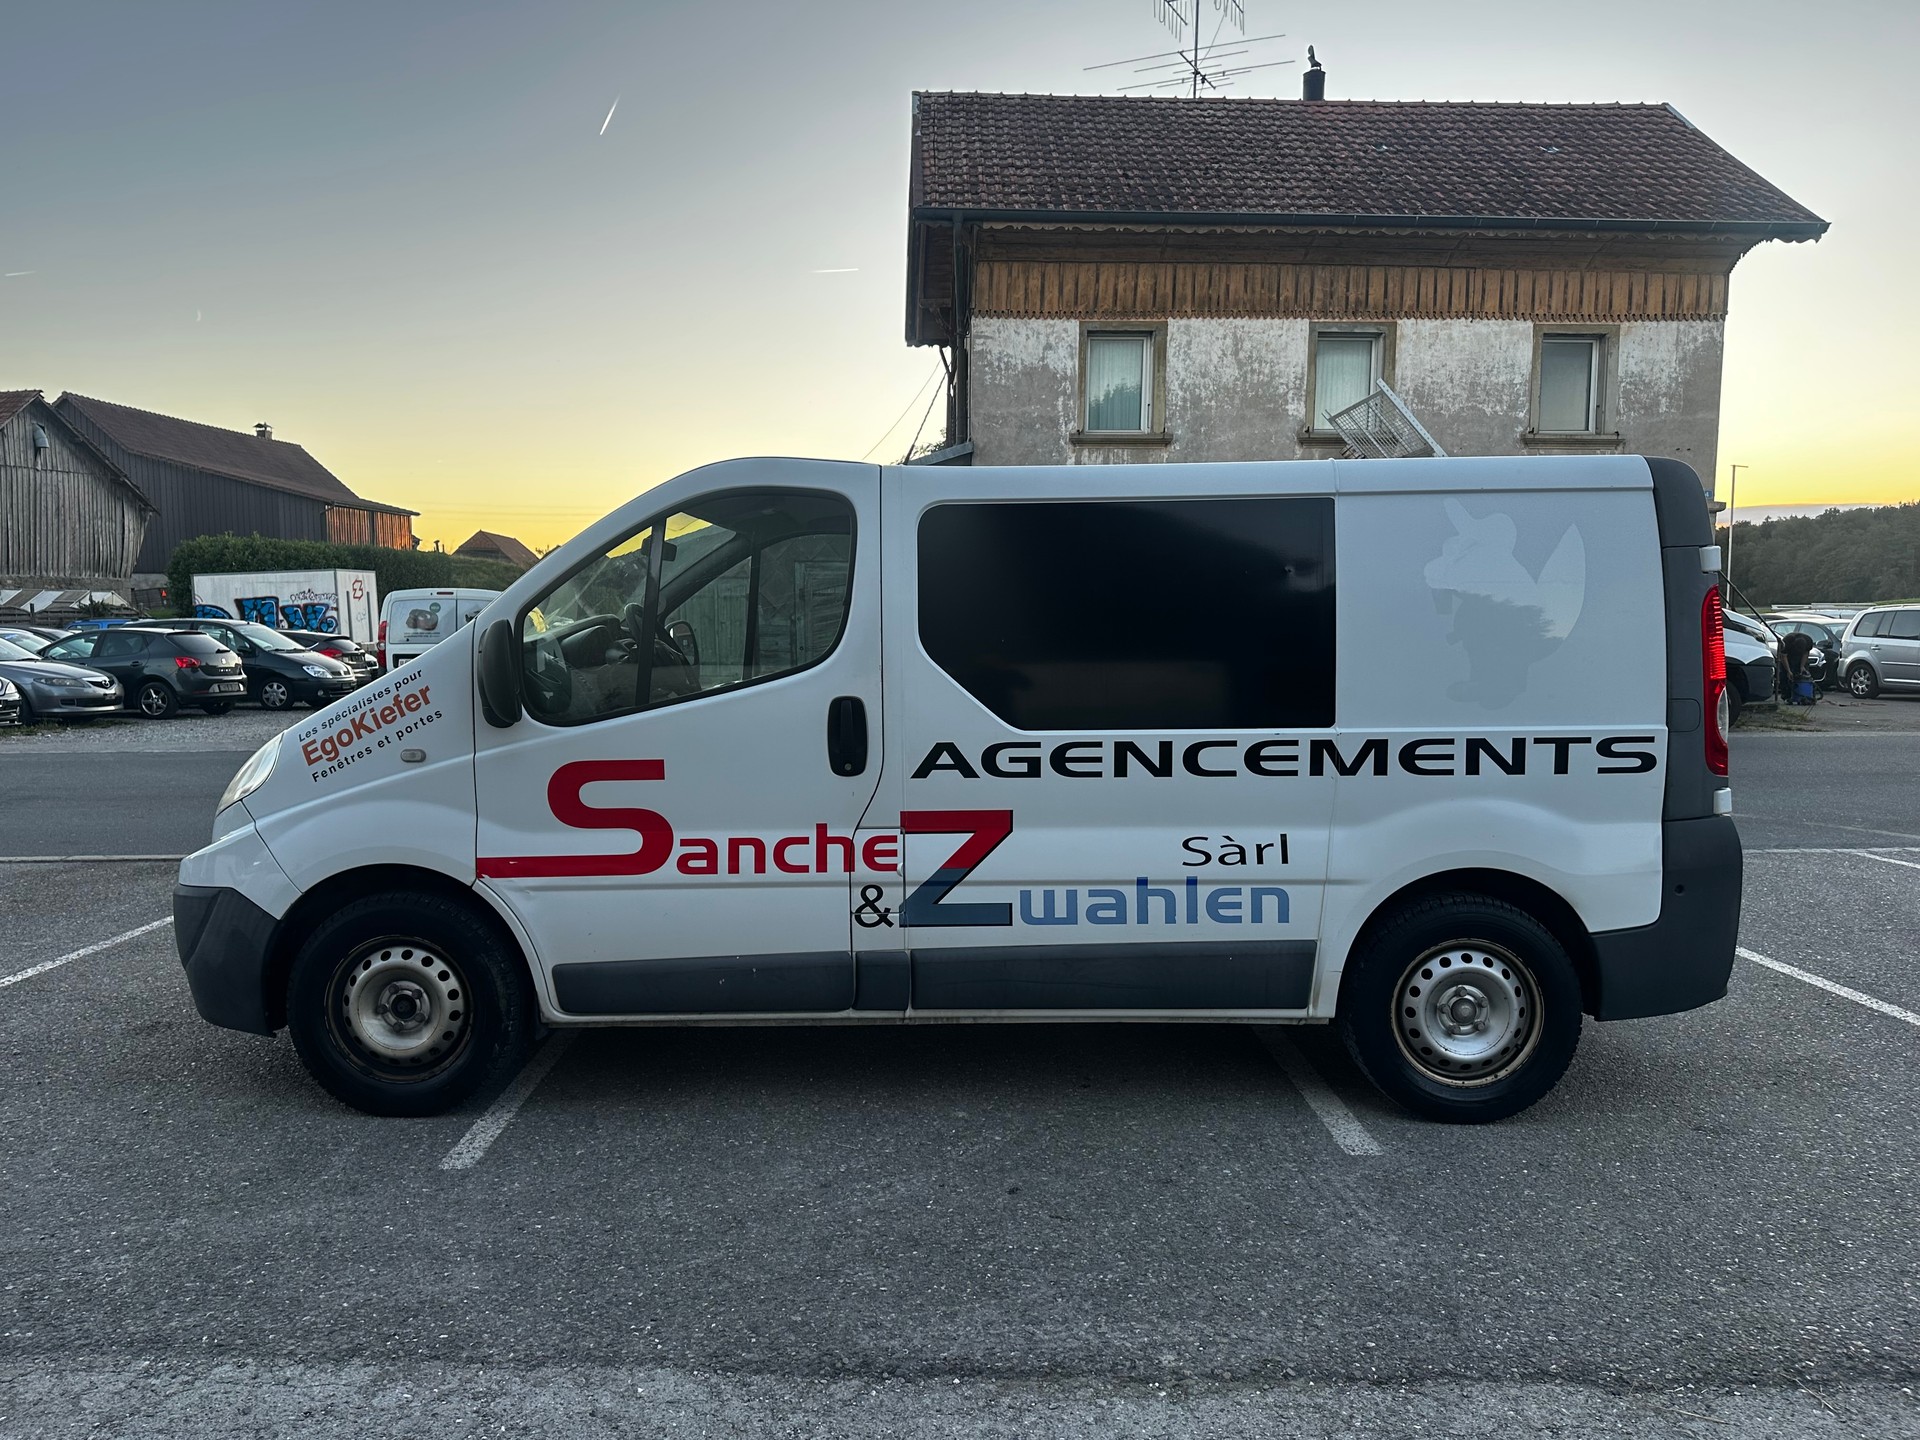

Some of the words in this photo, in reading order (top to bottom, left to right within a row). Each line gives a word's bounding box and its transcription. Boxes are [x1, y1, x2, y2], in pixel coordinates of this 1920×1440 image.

[298, 727, 318, 742] Les
[321, 687, 391, 730] spécialistes
[395, 668, 422, 691] pour
[301, 685, 431, 767] EgoKiefer
[312, 745, 373, 782] Fenêtres
[377, 736, 391, 748] et
[396, 709, 442, 740] portes
[911, 737, 1658, 778] AGENCEMENTS
[1182, 833, 1289, 866] Sàrl
[854, 884, 894, 928] &
